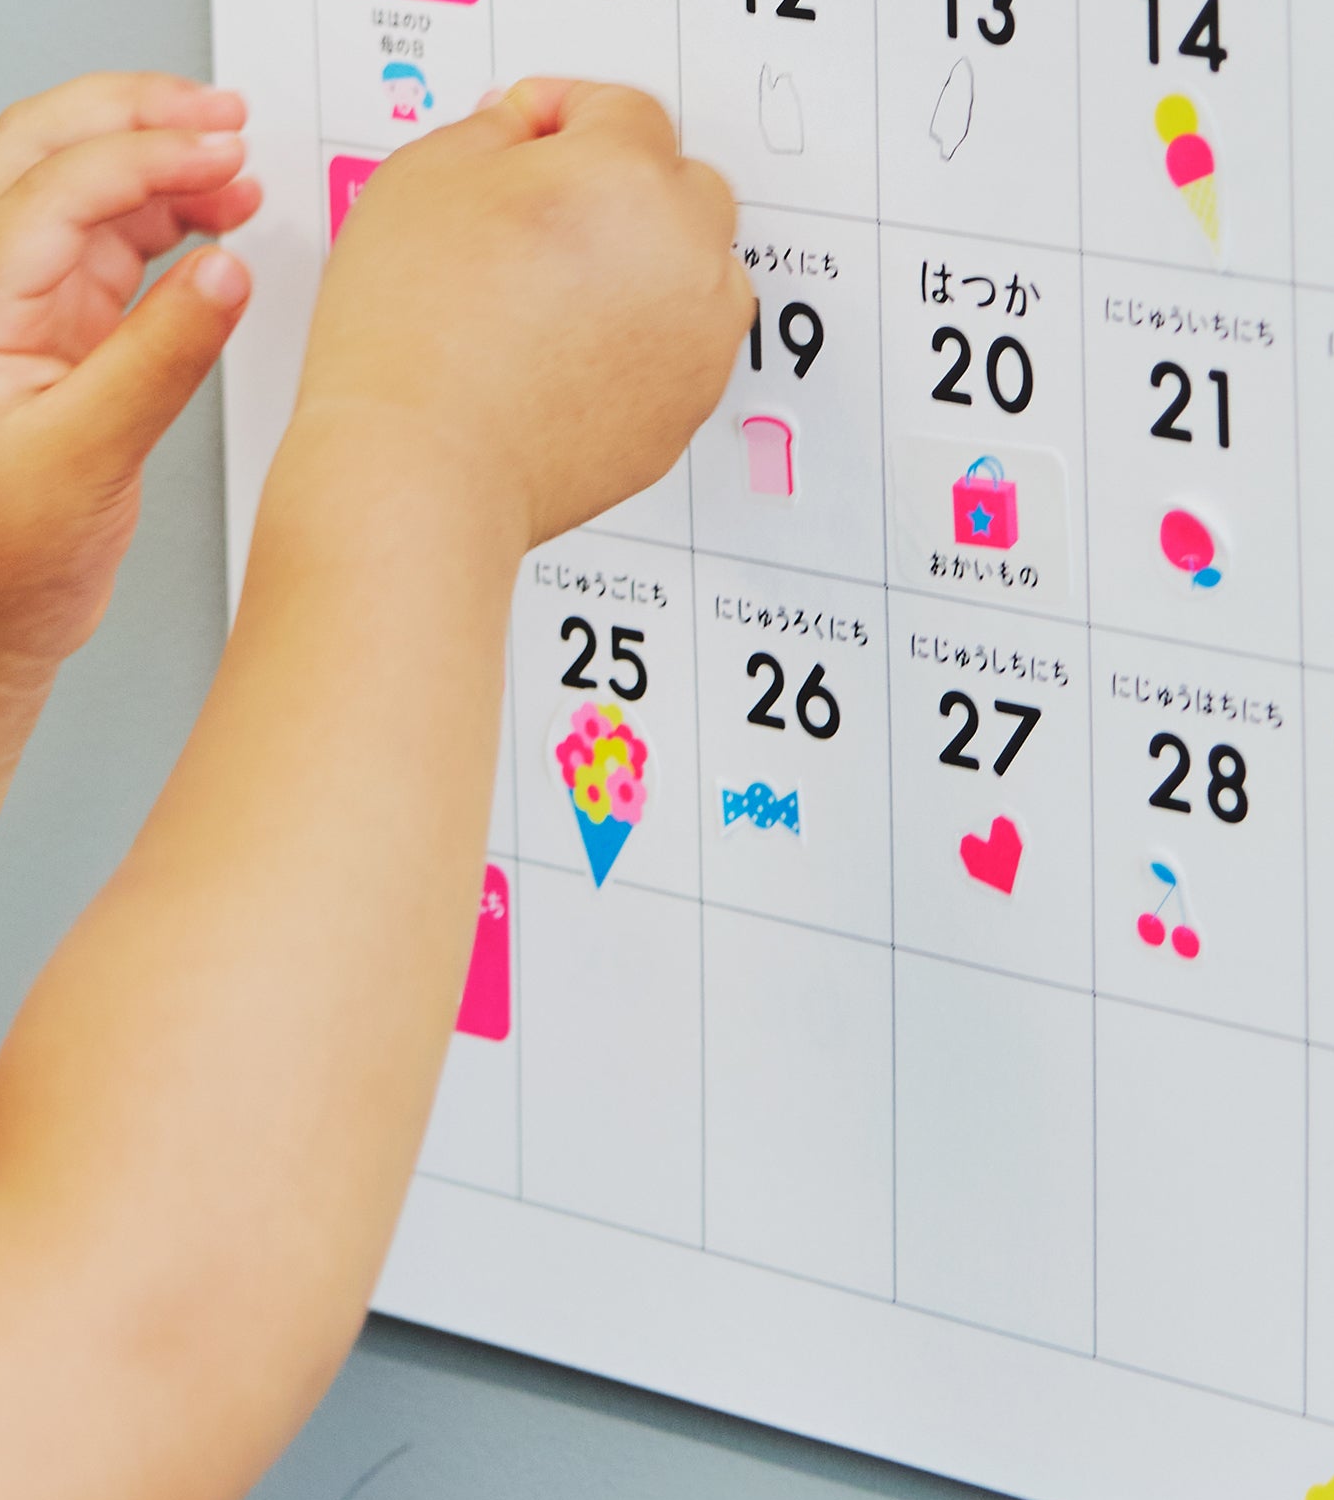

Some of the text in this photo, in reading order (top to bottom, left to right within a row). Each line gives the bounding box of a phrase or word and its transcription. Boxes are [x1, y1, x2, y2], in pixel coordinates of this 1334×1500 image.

[732, 243, 838, 279] ゅうくにち
[921, 261, 1040, 317] はつか
[750, 297, 824, 380] 19
[1105, 297, 1274, 347] にじゅういちにち
[931, 326, 1034, 415] 20
[1150, 360, 1230, 449] 21
[535, 562, 667, 608] にじゅうごにち
[930, 551, 1038, 588] おかいもの
[716, 596, 868, 647] にじゅうろくにち
[560, 615, 648, 702] 25
[911, 634, 1068, 687] にじゅうしちにち
[746, 651, 841, 740] 26
[1112, 673, 1283, 729] にじゅうはちにち
[939, 690, 1042, 777] 27
[1148, 732, 1249, 824] 28
